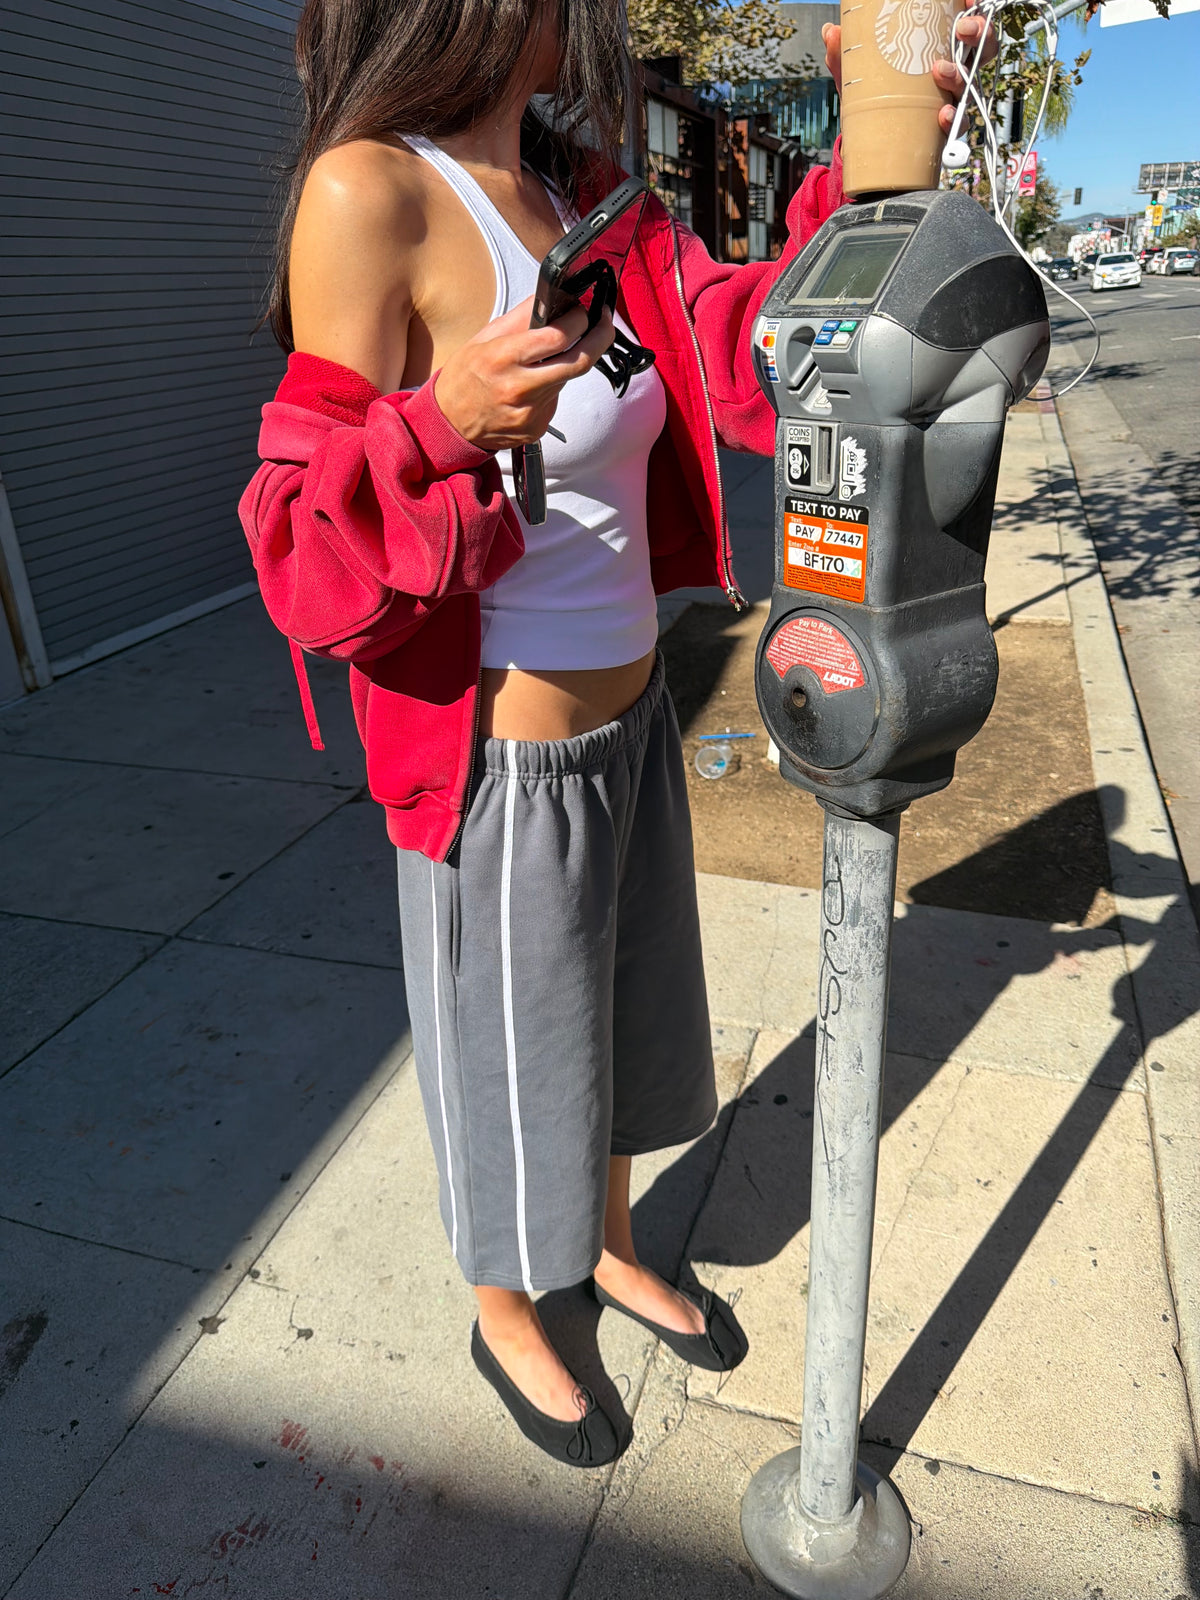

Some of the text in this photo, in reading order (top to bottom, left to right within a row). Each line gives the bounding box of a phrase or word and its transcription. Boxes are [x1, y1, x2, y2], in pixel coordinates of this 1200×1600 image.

[788, 428, 810, 436] COINS
[790, 500, 861, 521] TEXT TO PAY
[795, 525, 814, 538] PAY
[825, 531, 861, 546] 77447
[804, 552, 844, 573] BF170
[798, 619, 810, 627] Pay
[818, 622, 834, 634] Park
[823, 672, 856, 688] LADOT
